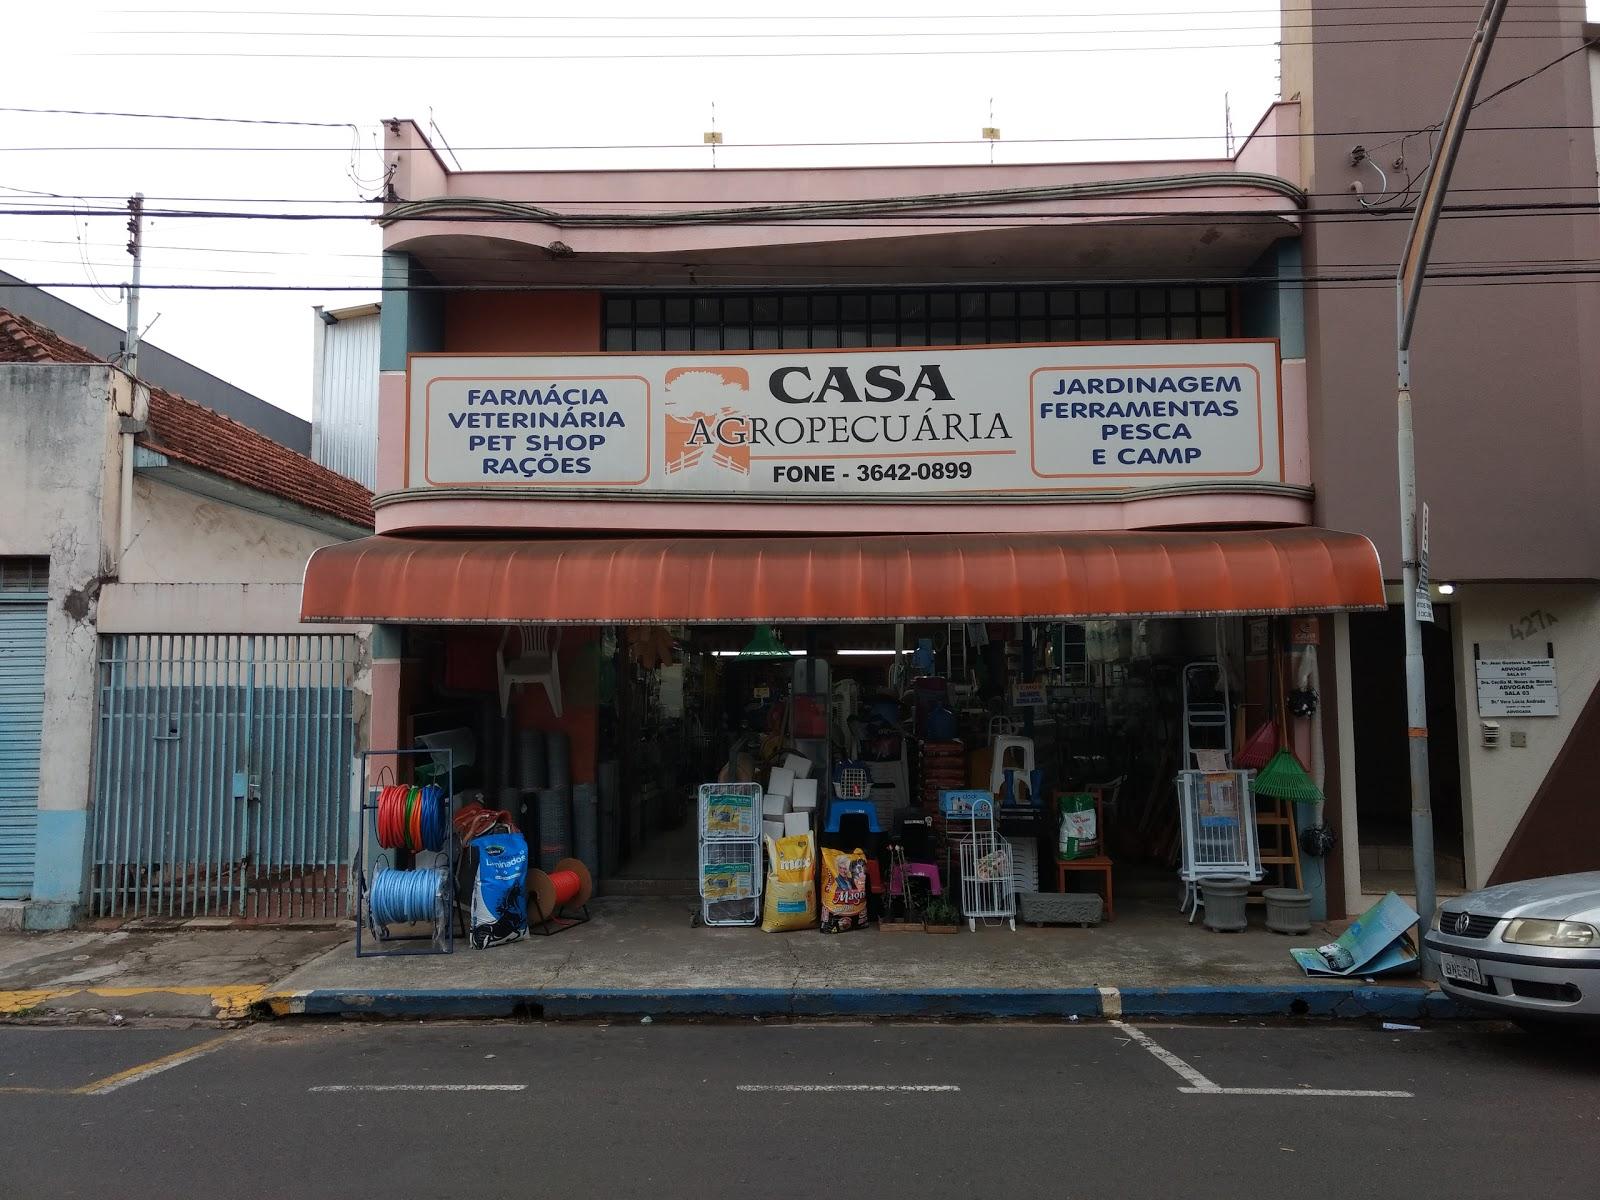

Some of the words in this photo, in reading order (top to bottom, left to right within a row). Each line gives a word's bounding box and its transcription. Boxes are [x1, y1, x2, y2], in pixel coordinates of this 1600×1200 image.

[468, 384, 609, 406] FARMÁCIA
[769, 365, 955, 404] CASA
[1053, 375, 1241, 395] JARDINAGEM
[448, 407, 625, 429] VETERINÁRIA
[1041, 399, 1239, 418] FERRAMENTAS
[686, 408, 1012, 447] AGROPECUÁRIA
[1102, 422, 1192, 441] PESCA
[469, 435, 517, 452] PET
[526, 434, 606, 452] SHOP
[482, 453, 591, 477] RAÇÕES
[1092, 448, 1106, 465] E
[1117, 448, 1202, 465] CAMP
[773, 465, 835, 483] FONE
[857, 461, 973, 482] 3642-0899
